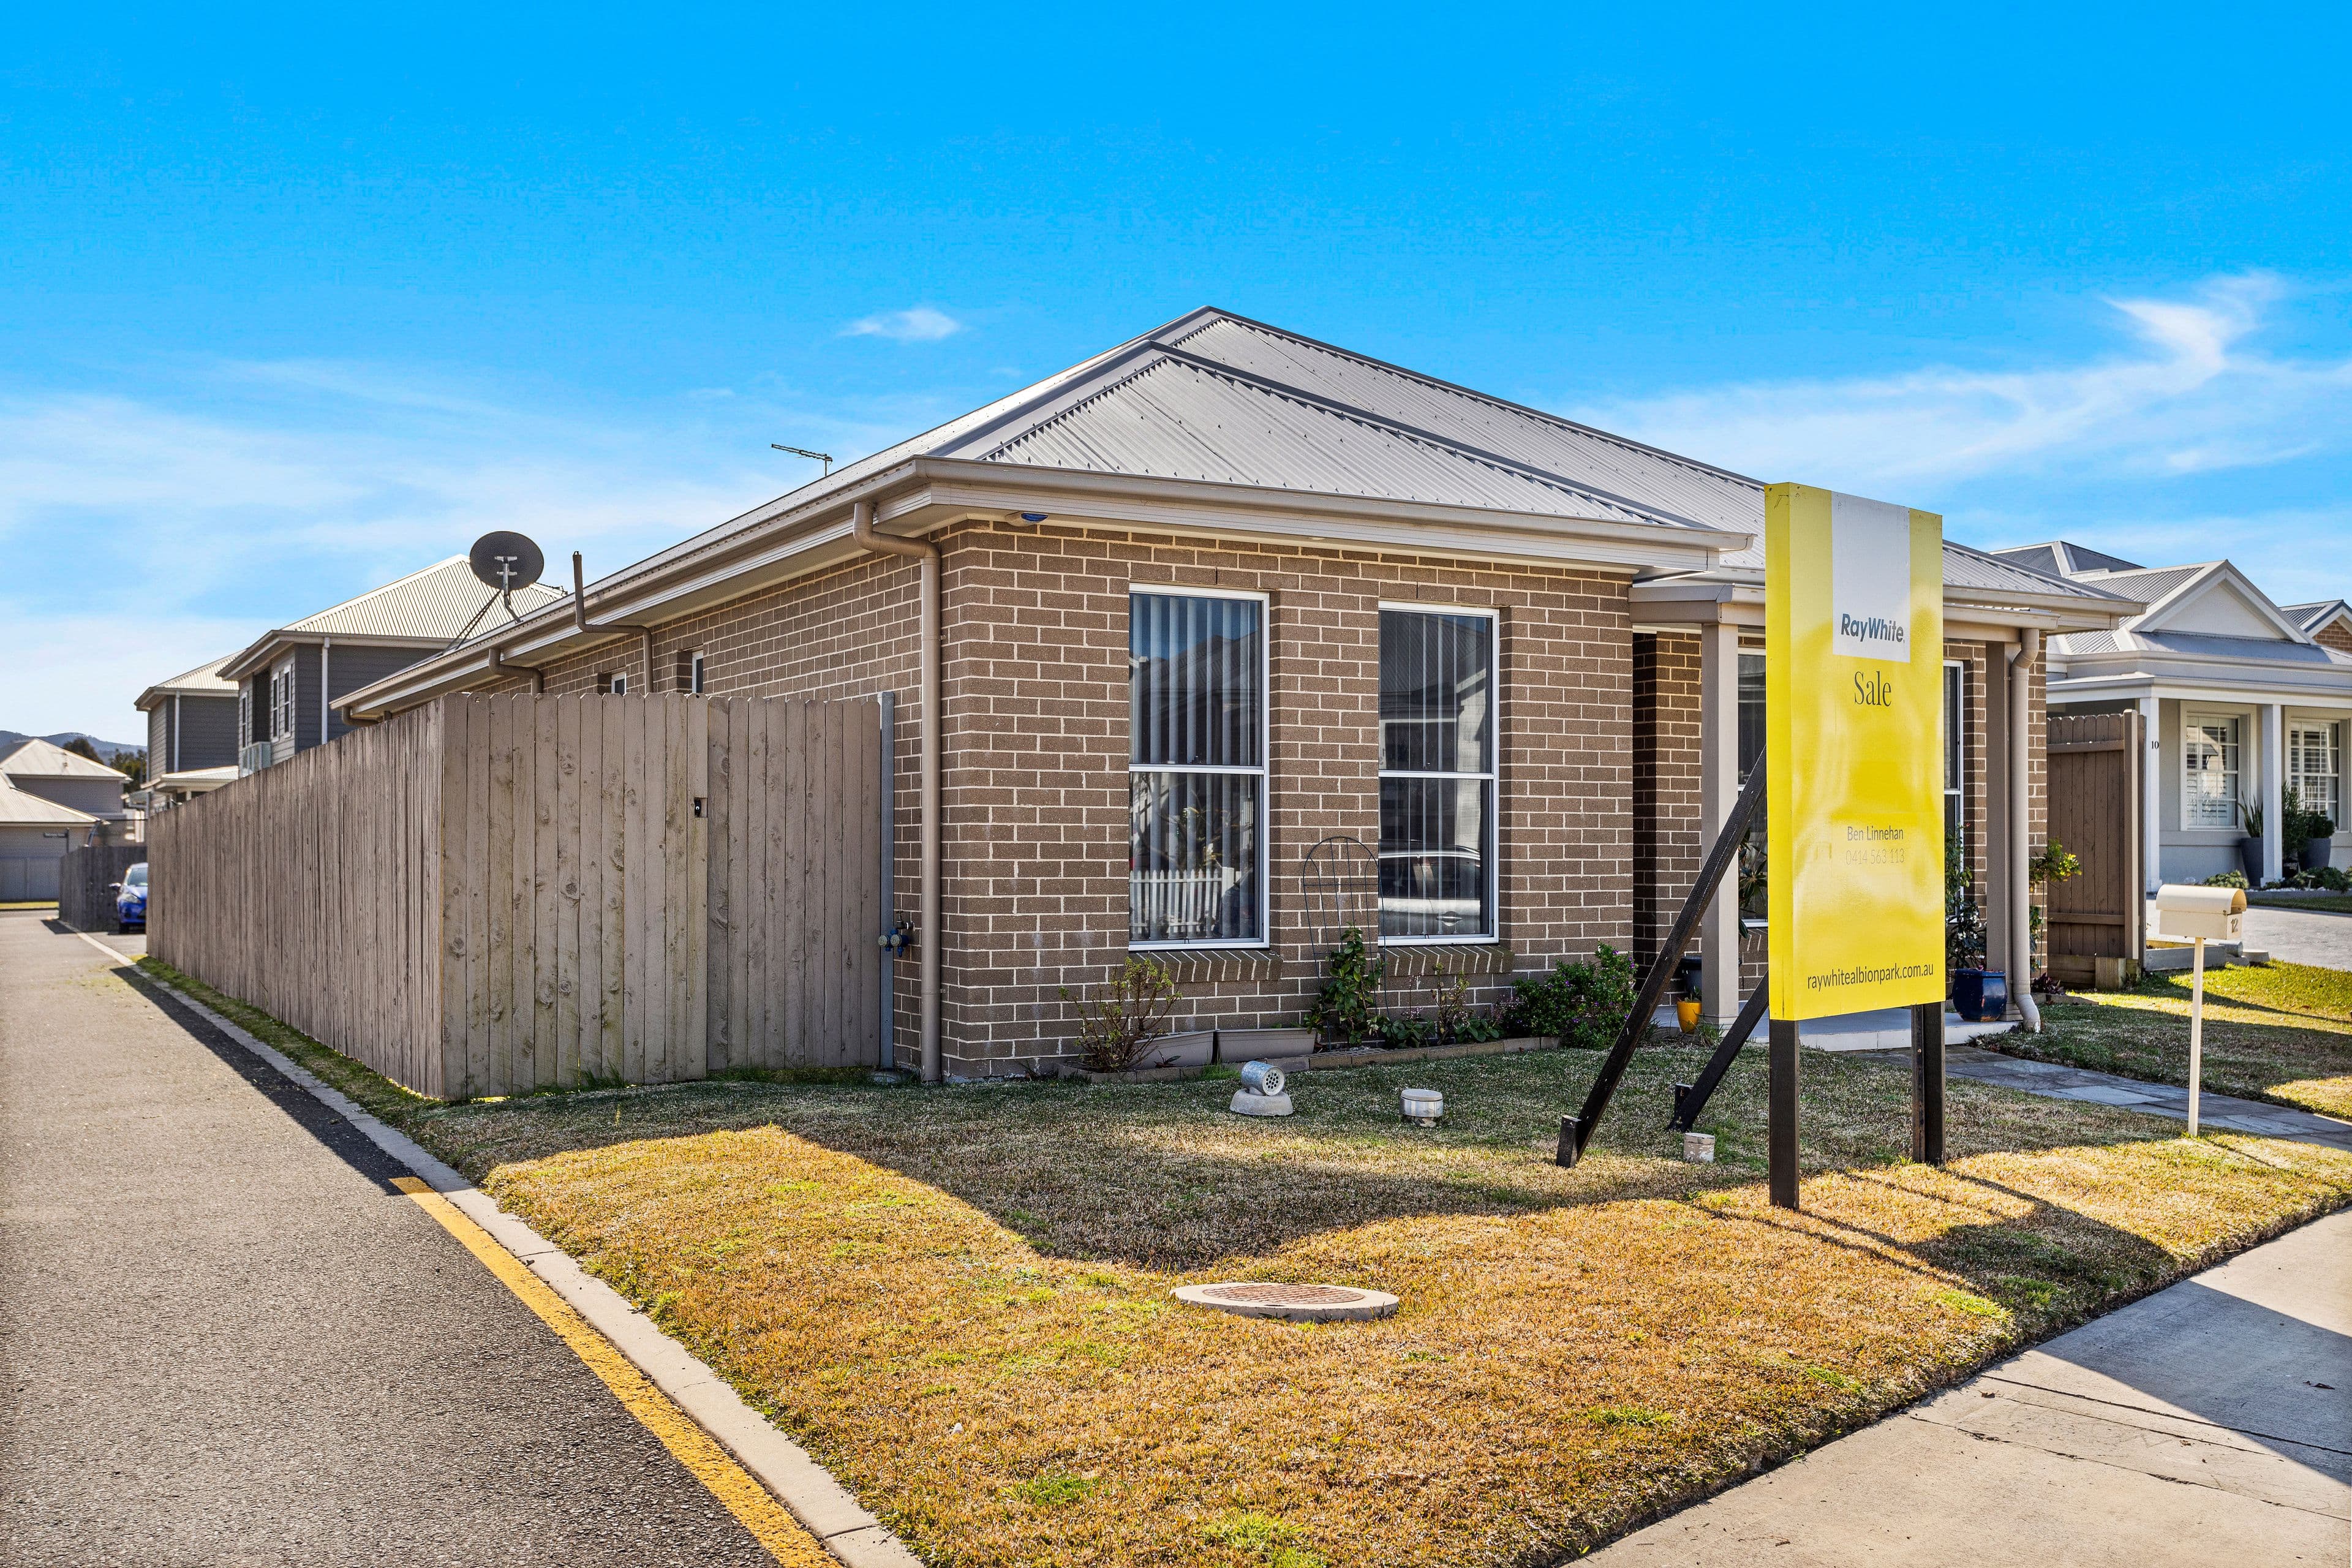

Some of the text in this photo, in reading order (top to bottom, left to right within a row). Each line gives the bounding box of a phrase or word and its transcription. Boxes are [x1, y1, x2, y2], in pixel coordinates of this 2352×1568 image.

[1854, 671, 1891, 707] Sale
[2151, 740, 2160, 750] 10
[1847, 825, 1904, 841] Ben Linnehan
[1845, 848, 1905, 865] 0414 563 113
[2230, 918, 2239, 933] 12
[1807, 963, 1934, 992] raywhitealbionpark.com.au
